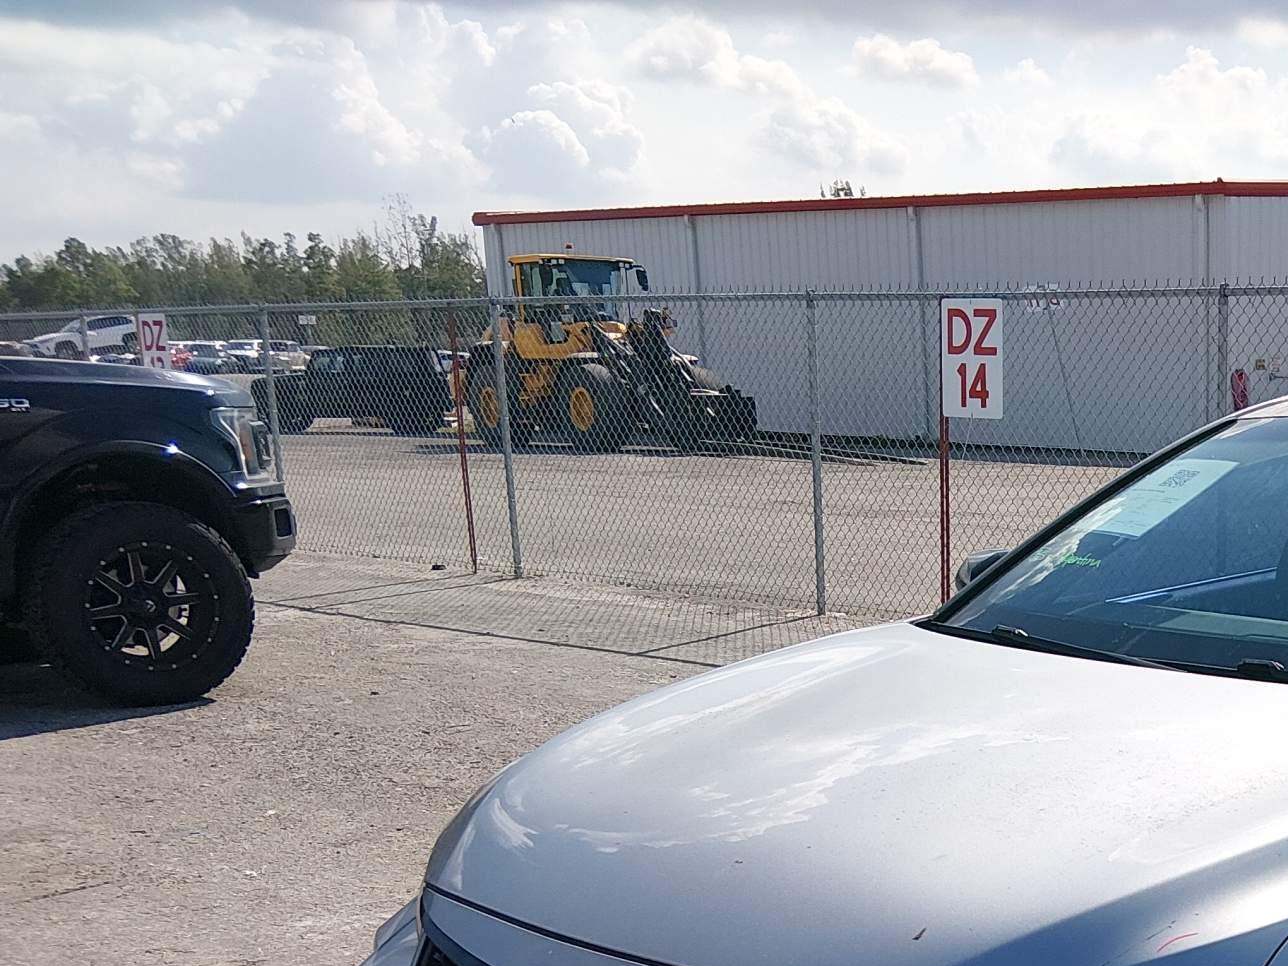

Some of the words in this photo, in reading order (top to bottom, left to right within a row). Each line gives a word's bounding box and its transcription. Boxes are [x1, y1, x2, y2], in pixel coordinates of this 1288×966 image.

[141, 320, 166, 351] DZ
[947, 308, 997, 355] DZ
[957, 363, 989, 408] 14
